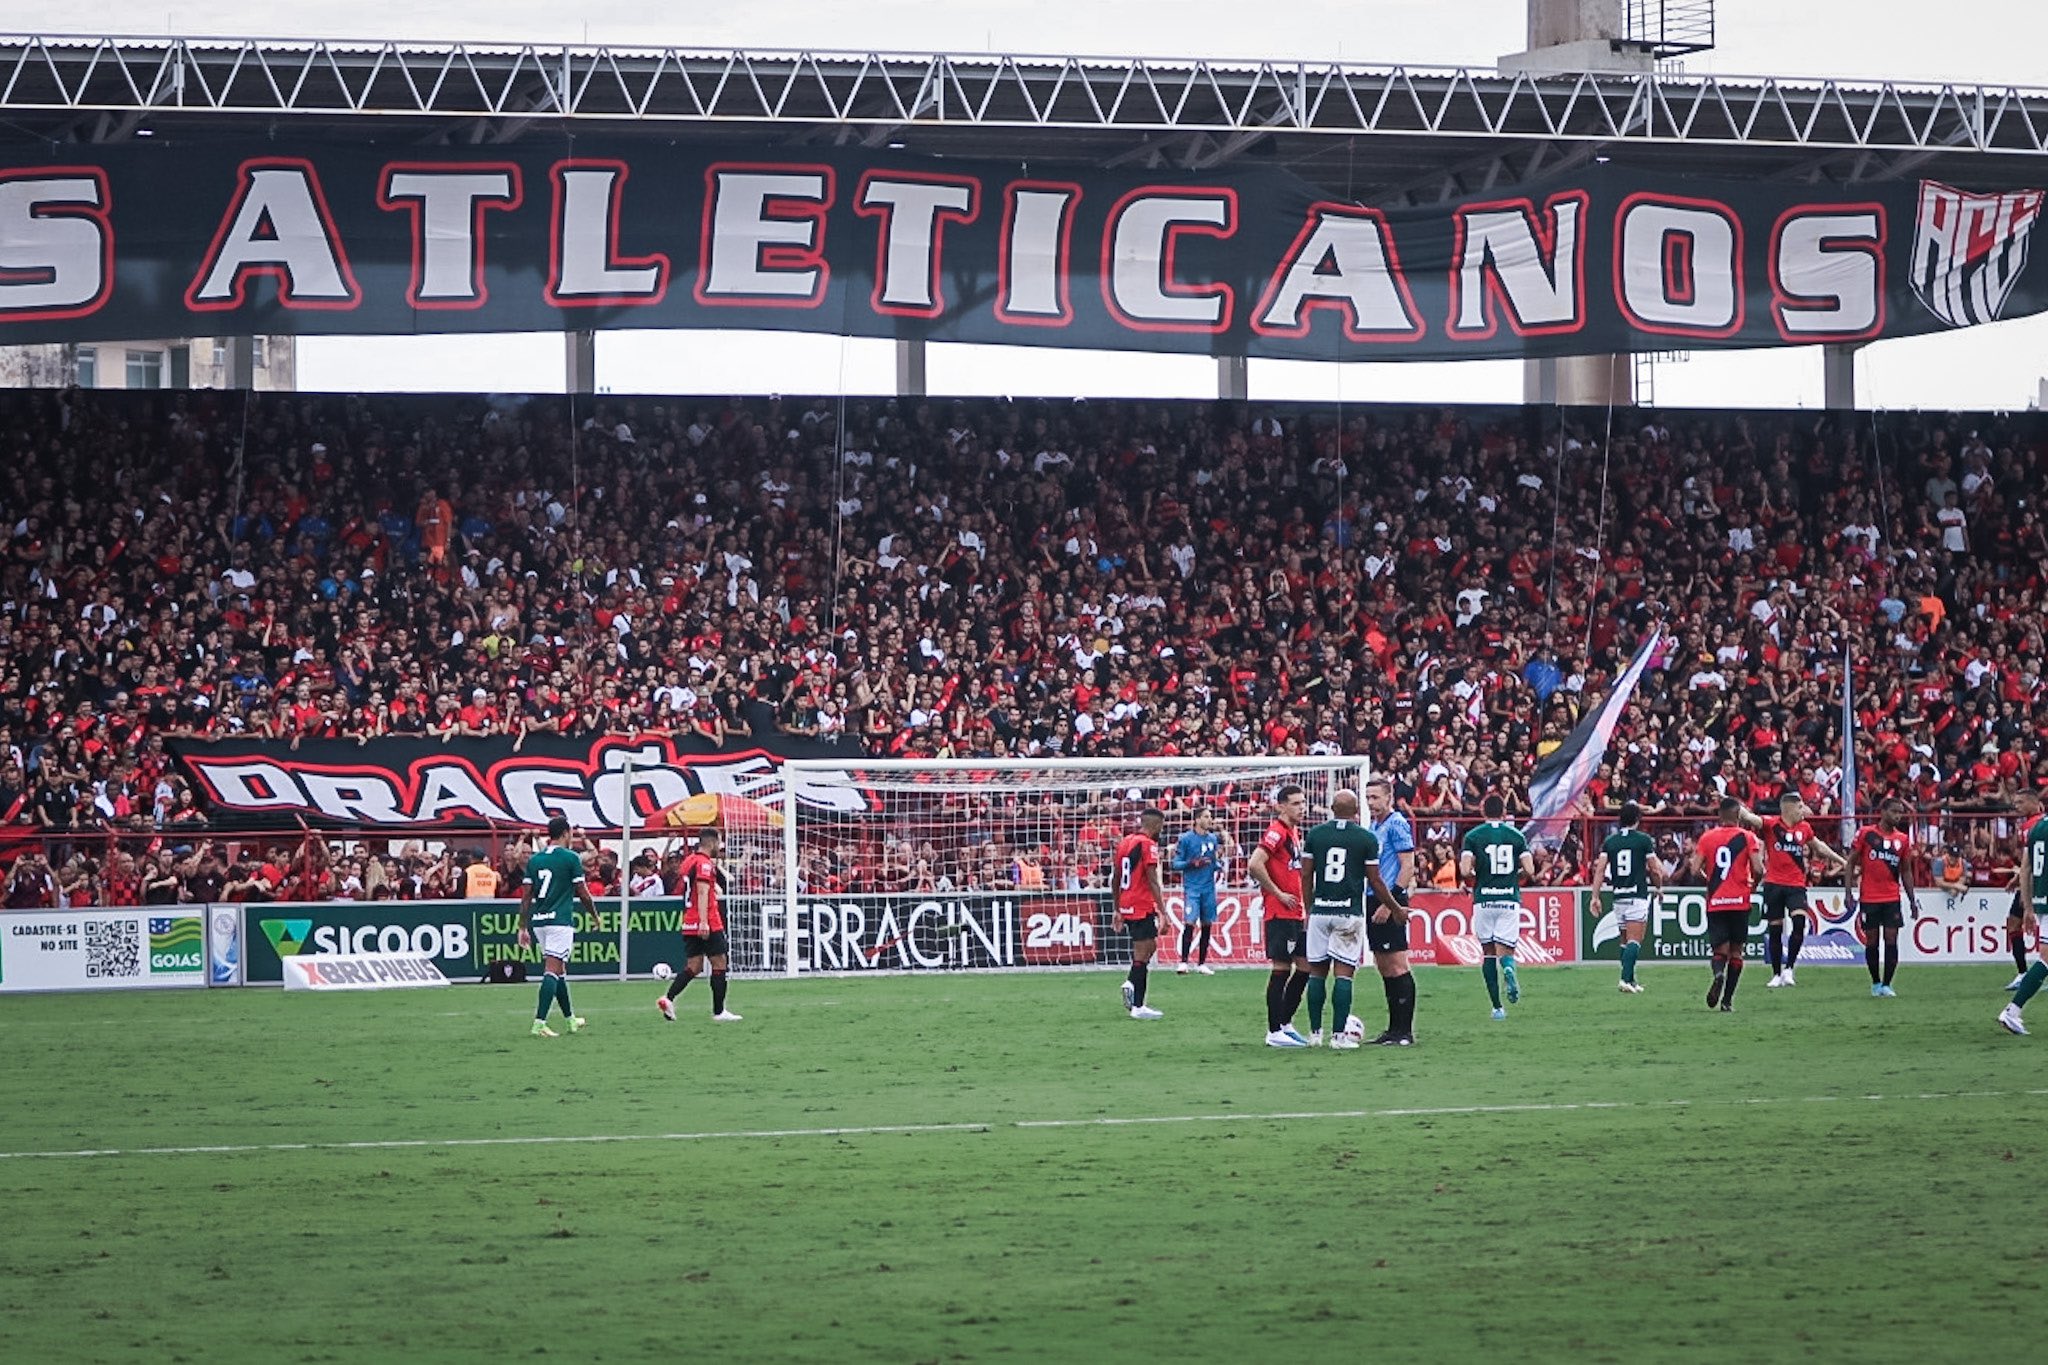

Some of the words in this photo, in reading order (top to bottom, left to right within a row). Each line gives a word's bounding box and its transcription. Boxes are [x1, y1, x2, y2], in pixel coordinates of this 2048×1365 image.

[184, 155, 1888, 342] ATLETICANOS
[186, 739, 882, 830] DRAGÕES
[1121, 856, 1131, 891] 8
[1325, 847, 1347, 883] 8
[1485, 844, 1514, 875] 19
[1617, 850, 1632, 877] 9
[1716, 846, 1732, 881] 9
[537, 869, 552, 898] 7
[12, 924, 78, 936] CADASTRE-SE
[762, 901, 1014, 968] FERRACINI
[1026, 912, 1094, 948] 24h
[1547, 896, 1562, 942] shop
[41, 941, 56, 951] NO
[58, 940, 78, 951] SITE
[314, 924, 469, 959] SICOOB
[297, 960, 376, 985] XBRI
[368, 959, 442, 981] PNEUS
